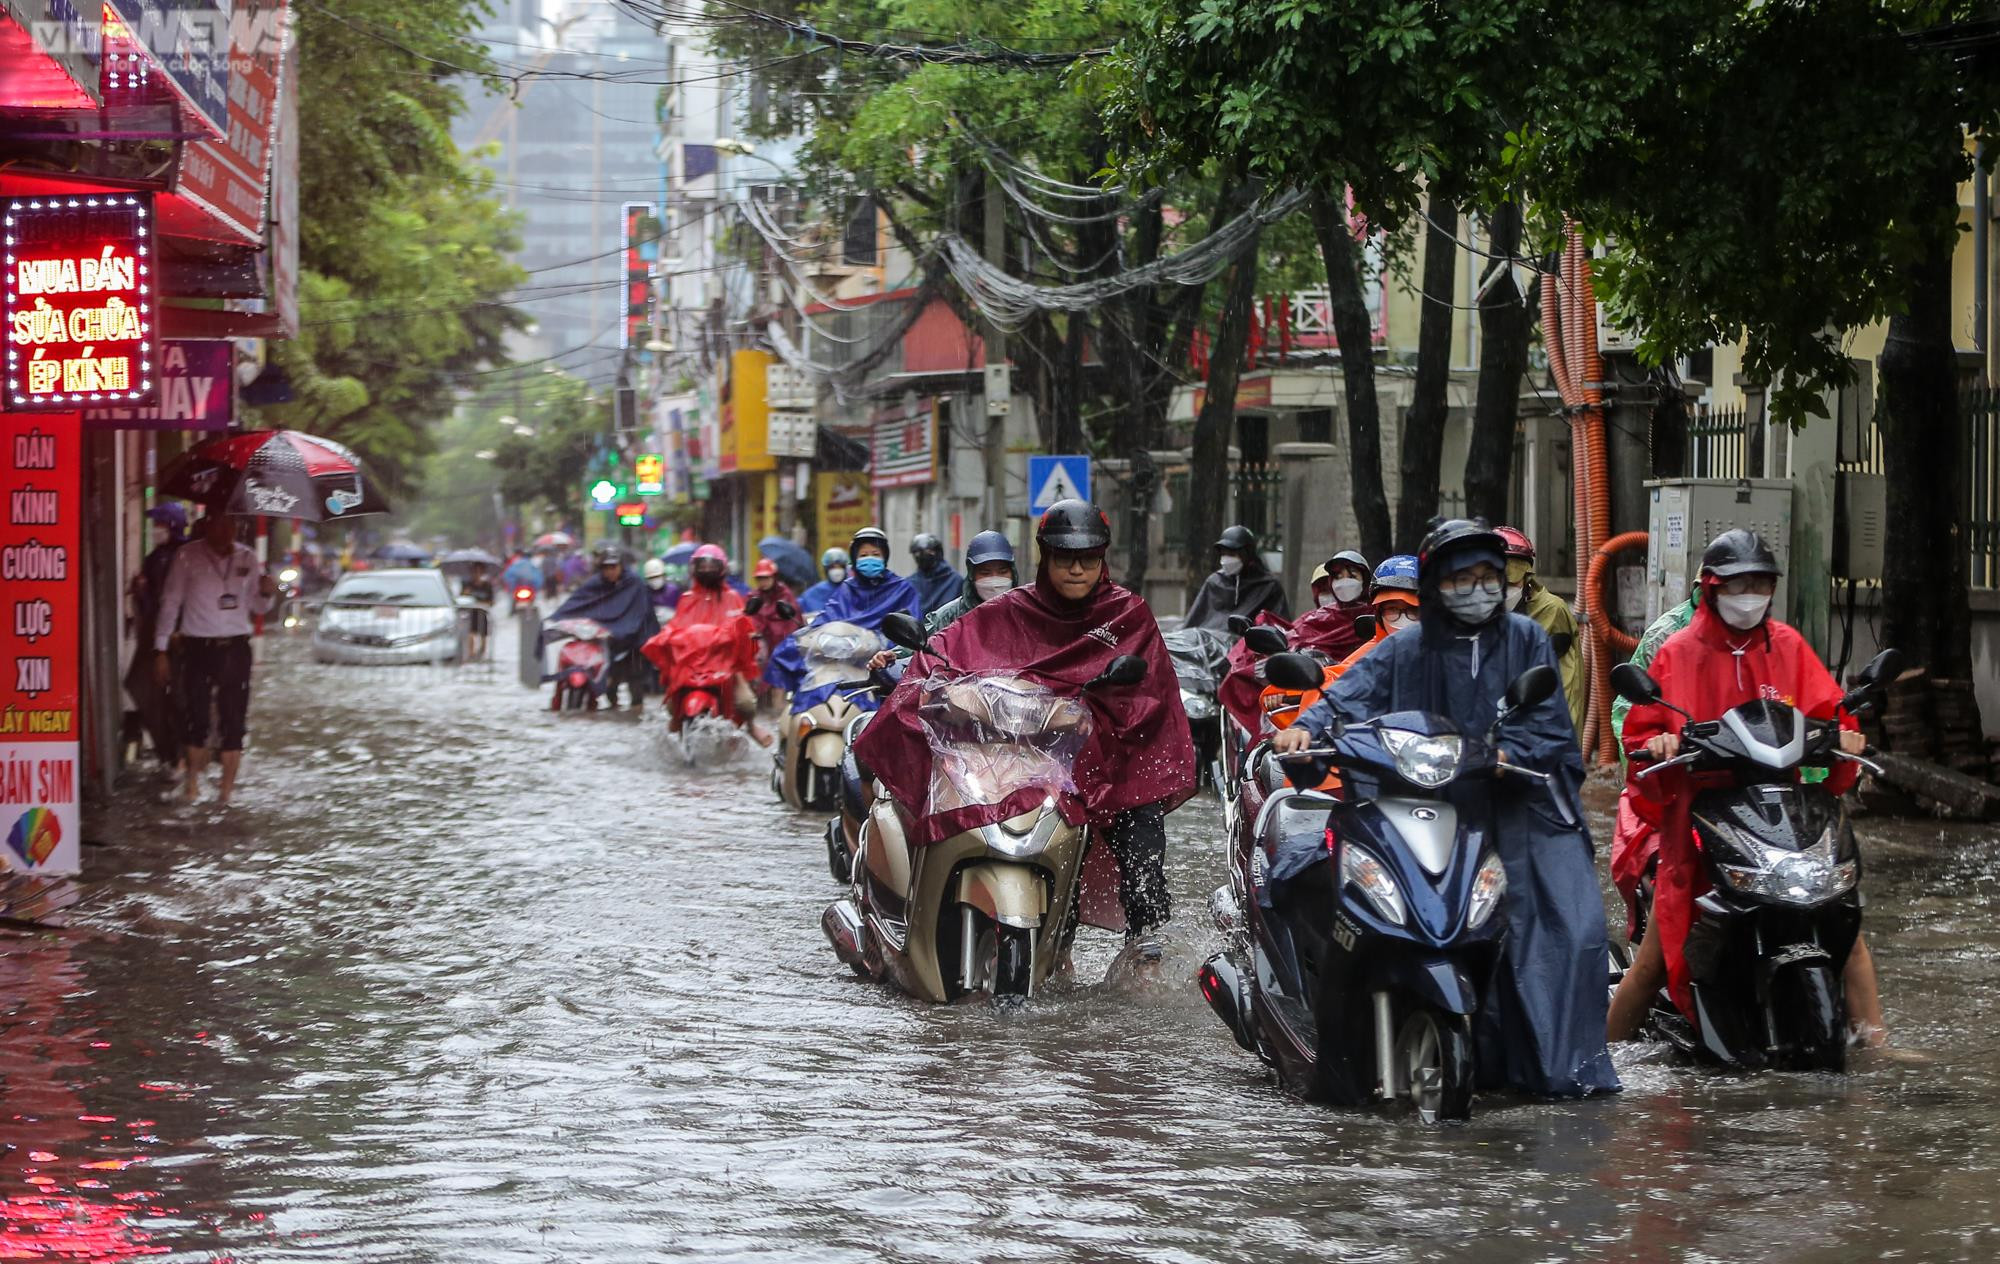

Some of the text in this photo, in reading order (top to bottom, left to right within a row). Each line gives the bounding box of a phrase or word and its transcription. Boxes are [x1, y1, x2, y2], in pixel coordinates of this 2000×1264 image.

[18, 245, 135, 295] MUA BÁN
[14, 296, 143, 345] SỬA CHỮA
[28, 346, 129, 394] ÉP KÍNH
[15, 428, 55, 469] DÁN
[11, 483, 57, 524] KÍNH
[15, 597, 52, 643] LỰC
[15, 657, 51, 699] XỊN
[28, 710, 72, 734] NGAY
[38, 759, 73, 804] SIM
